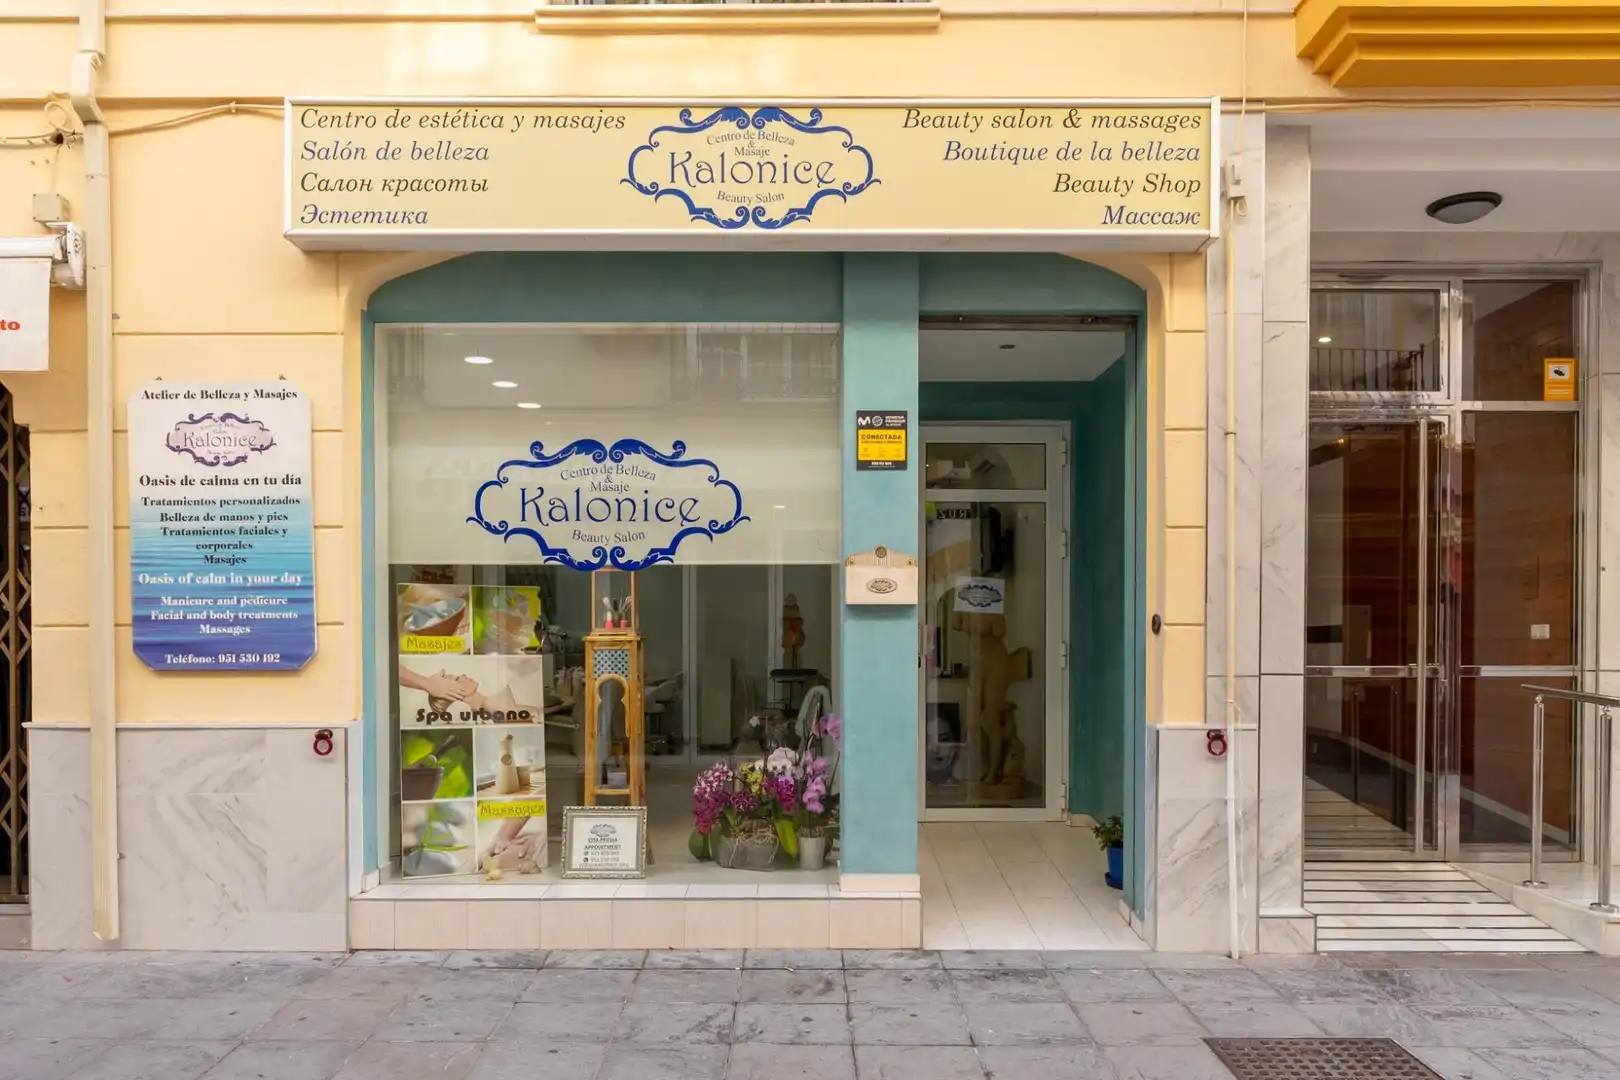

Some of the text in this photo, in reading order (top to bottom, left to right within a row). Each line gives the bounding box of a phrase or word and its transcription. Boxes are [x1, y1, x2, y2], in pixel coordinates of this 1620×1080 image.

[301, 108, 626, 132] Centro de estética y masajes
[902, 108, 1201, 133] Beauty salon & massages
[706, 130, 796, 146] Centro de Belleza
[747, 140, 755, 148] &
[300, 140, 489, 161] Salón de belleza
[734, 146, 771, 157] Masaje
[943, 140, 1201, 165] Boutique de la belleza
[669, 150, 836, 188] Kalonice
[300, 172, 489, 197] Салон красоты
[1053, 173, 1201, 197] Beauty Shop
[717, 190, 785, 205] Beauty Salon
[300, 204, 429, 225] Эстетика
[1101, 205, 1200, 225] Массаж
[142, 388, 298, 401] Atelier de Belleza y Masajes
[183, 431, 258, 449] Kalonice
[560, 464, 656, 481] Centro de Belleza
[604, 475, 614, 484] &
[139, 474, 302, 486] Oasis de calma en tu día
[590, 482, 630, 494] Masaje
[142, 496, 301, 508] Tratamientos personalizados
[519, 486, 701, 527] Kalonice
[160, 512, 288, 524] Belleza de manos y pies
[161, 526, 287, 537] Tratamientos faciales y
[572, 529, 646, 546] Beauty Salon
[196, 541, 253, 551] corporales
[203, 554, 247, 566] Masajes
[138, 572, 303, 586] Oasis of calm in your day
[161, 596, 215, 606] Manicure
[217, 596, 237, 606] and
[150, 610, 299, 622] Facial and body treatments
[199, 624, 251, 635] Massages
[406, 637, 463, 650] Masajes
[165, 653, 280, 664] Teléfono: 951 530 192
[416, 708, 531, 725] Spa urbano
[480, 804, 545, 818] Massages
